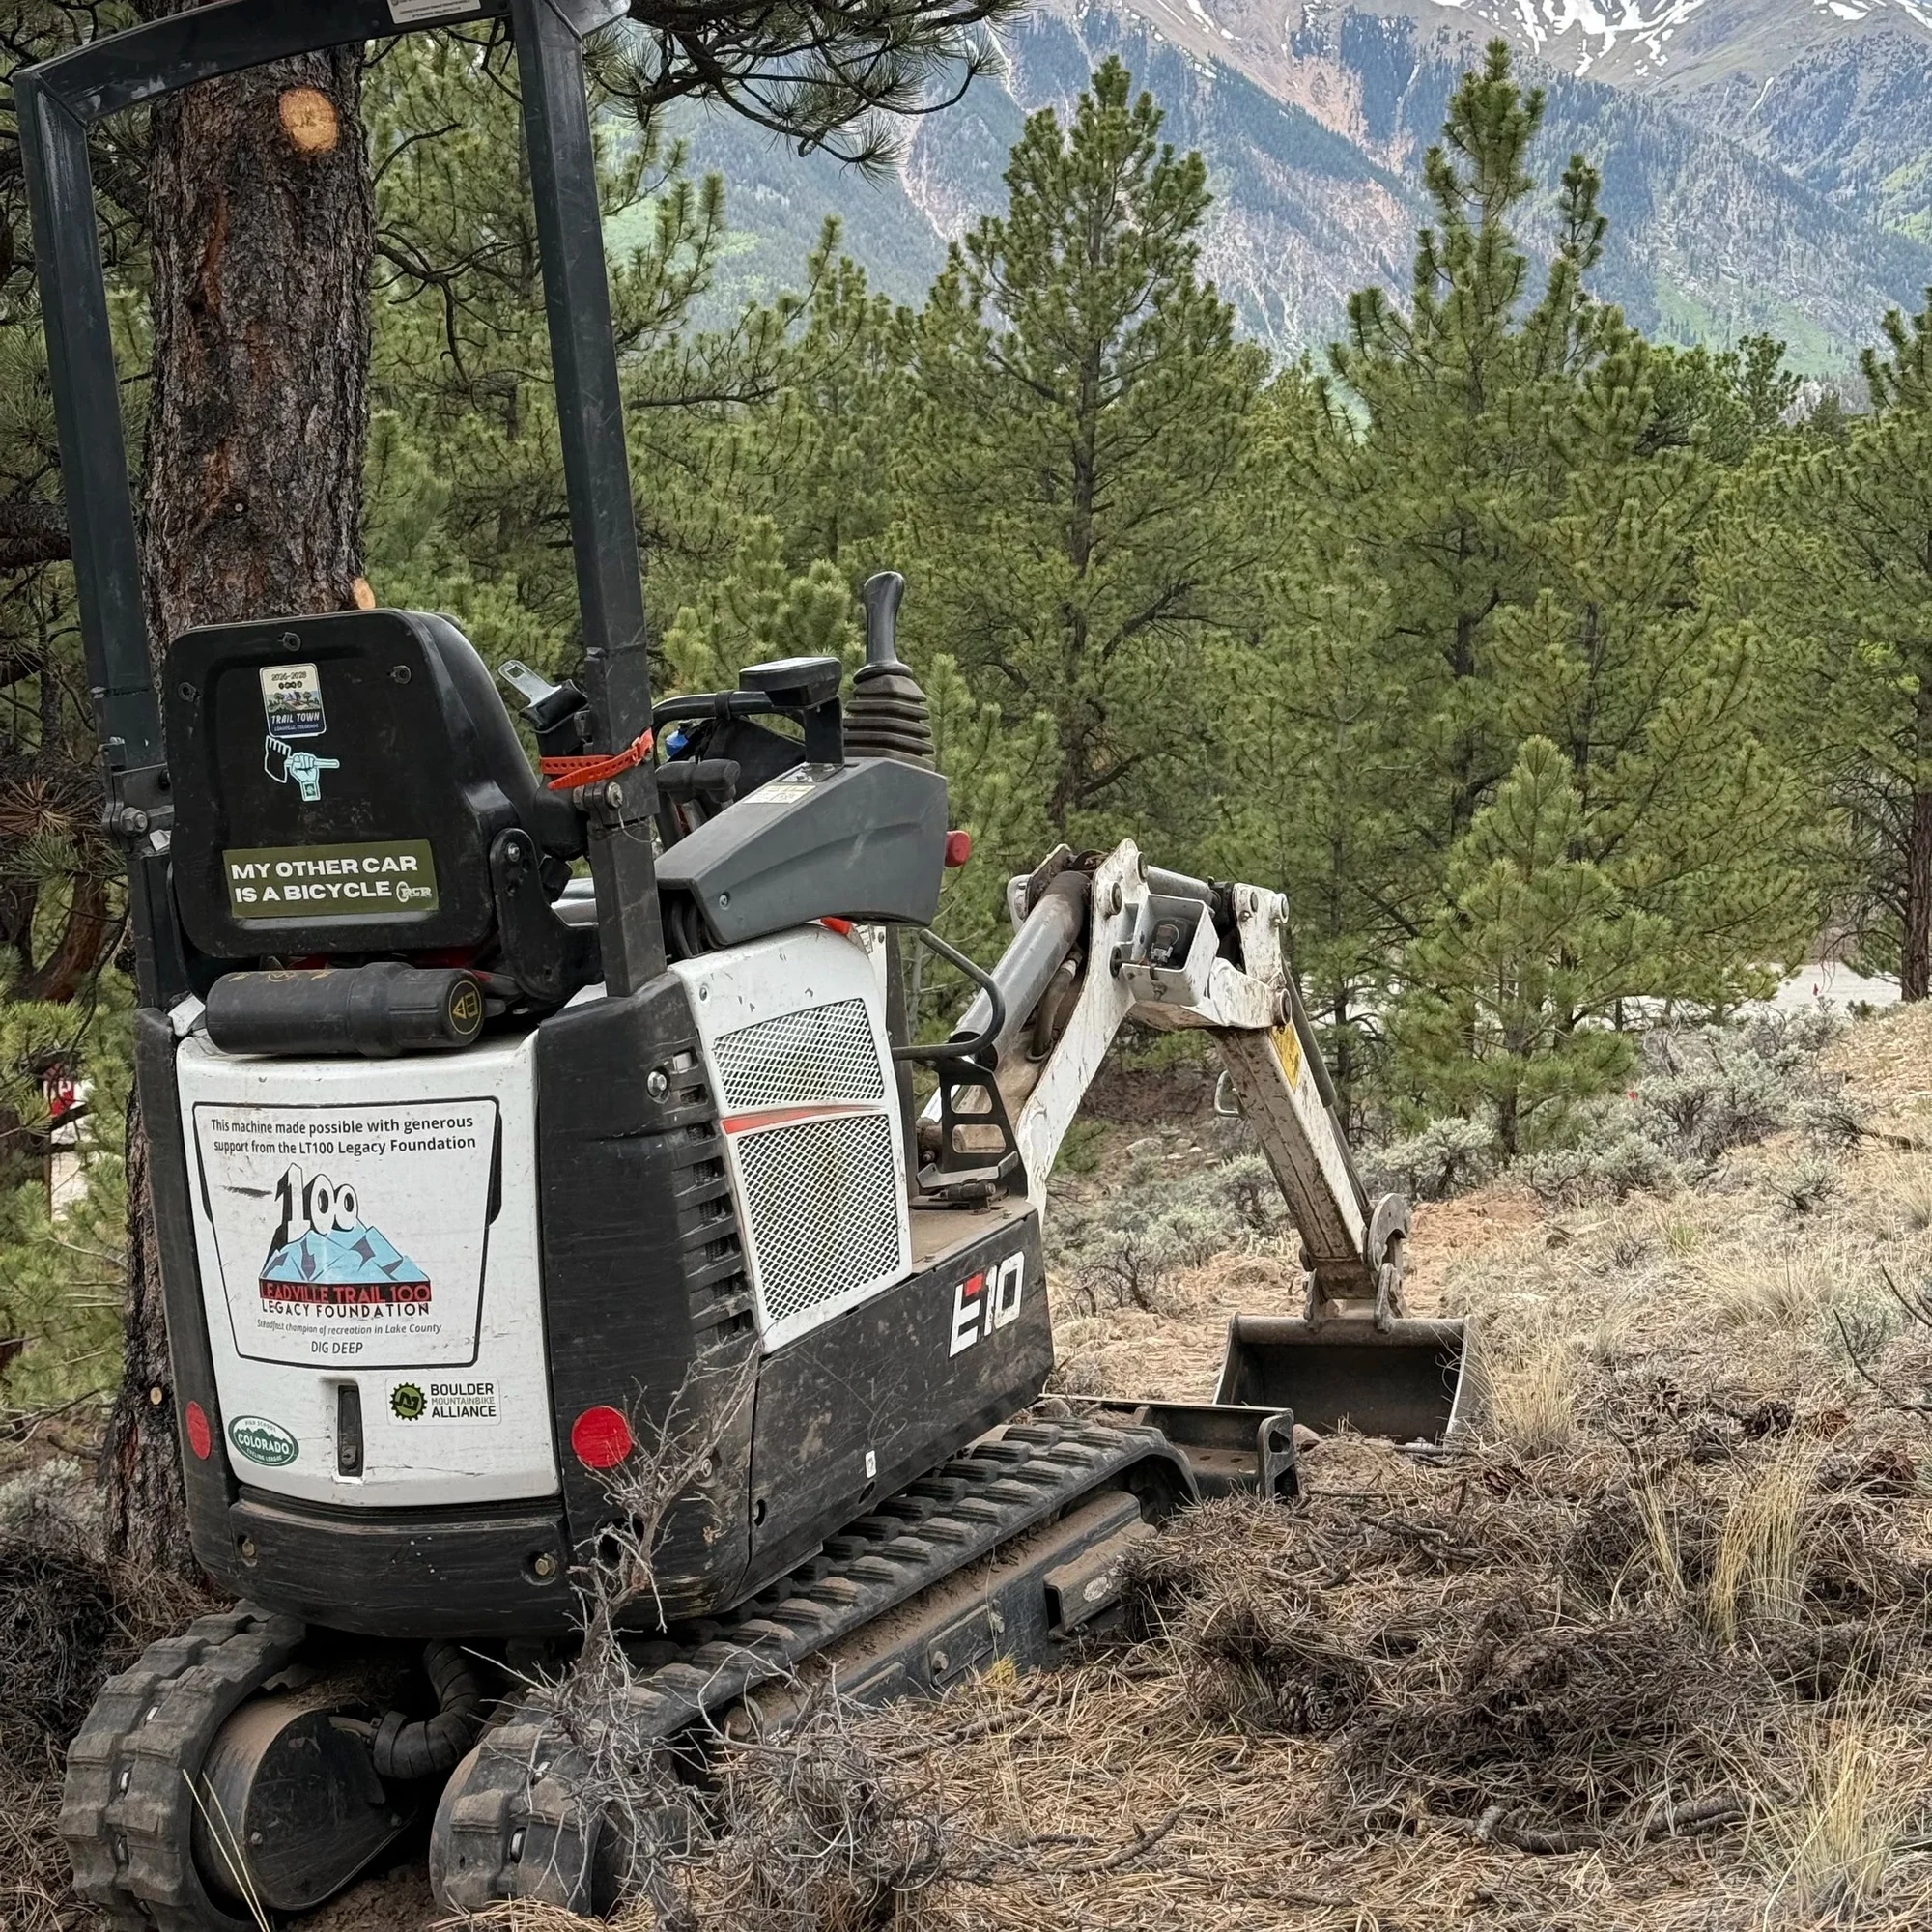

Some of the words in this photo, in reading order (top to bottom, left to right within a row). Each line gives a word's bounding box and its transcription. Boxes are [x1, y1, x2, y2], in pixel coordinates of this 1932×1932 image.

[271, 714, 294, 724] TRAIL
[297, 712, 320, 723] TOWN
[231, 863, 270, 879] MY
[275, 859, 359, 877] OTHER
[362, 856, 418, 872] CAR
[235, 887, 258, 902] IS
[262, 886, 281, 901] A
[283, 881, 392, 900] BICYCLE
[211, 1119, 230, 1132] This
[232, 1120, 272, 1134] machine
[275, 1122, 306, 1134] made
[309, 1120, 363, 1138] possible
[367, 1119, 400, 1132] with
[404, 1117, 473, 1134] generous
[213, 1141, 249, 1155] support
[251, 1140, 275, 1153] from
[278, 1141, 297, 1153] the
[299, 1141, 334, 1154] LT100
[338, 1142, 385, 1156] Legacy
[390, 1135, 476, 1151] Foundation
[274, 1162, 358, 1240] 100
[261, 1282, 329, 1303] LEADVILLE
[333, 1285, 386, 1303] TRAIL
[390, 1285, 430, 1302] 100
[262, 1299, 309, 1317] LEGACY
[316, 1302, 429, 1318] FOUNDATION
[949, 1250, 1025, 1358] E10
[257, 1319, 285, 1330] Steadfast
[285, 1322, 318, 1335] champion
[319, 1324, 327, 1336] of
[328, 1323, 372, 1335] recreation
[374, 1324, 383, 1334] in
[385, 1323, 407, 1334] Lake
[409, 1322, 442, 1335] County
[311, 1340, 329, 1353] DIG
[332, 1341, 363, 1354] DEEP
[430, 1383, 494, 1396] BOULDER
[431, 1396, 496, 1406] MOUNTAINBIKE
[431, 1406, 497, 1418] ALLIANCE
[238, 1433, 290, 1455] COLORADO
